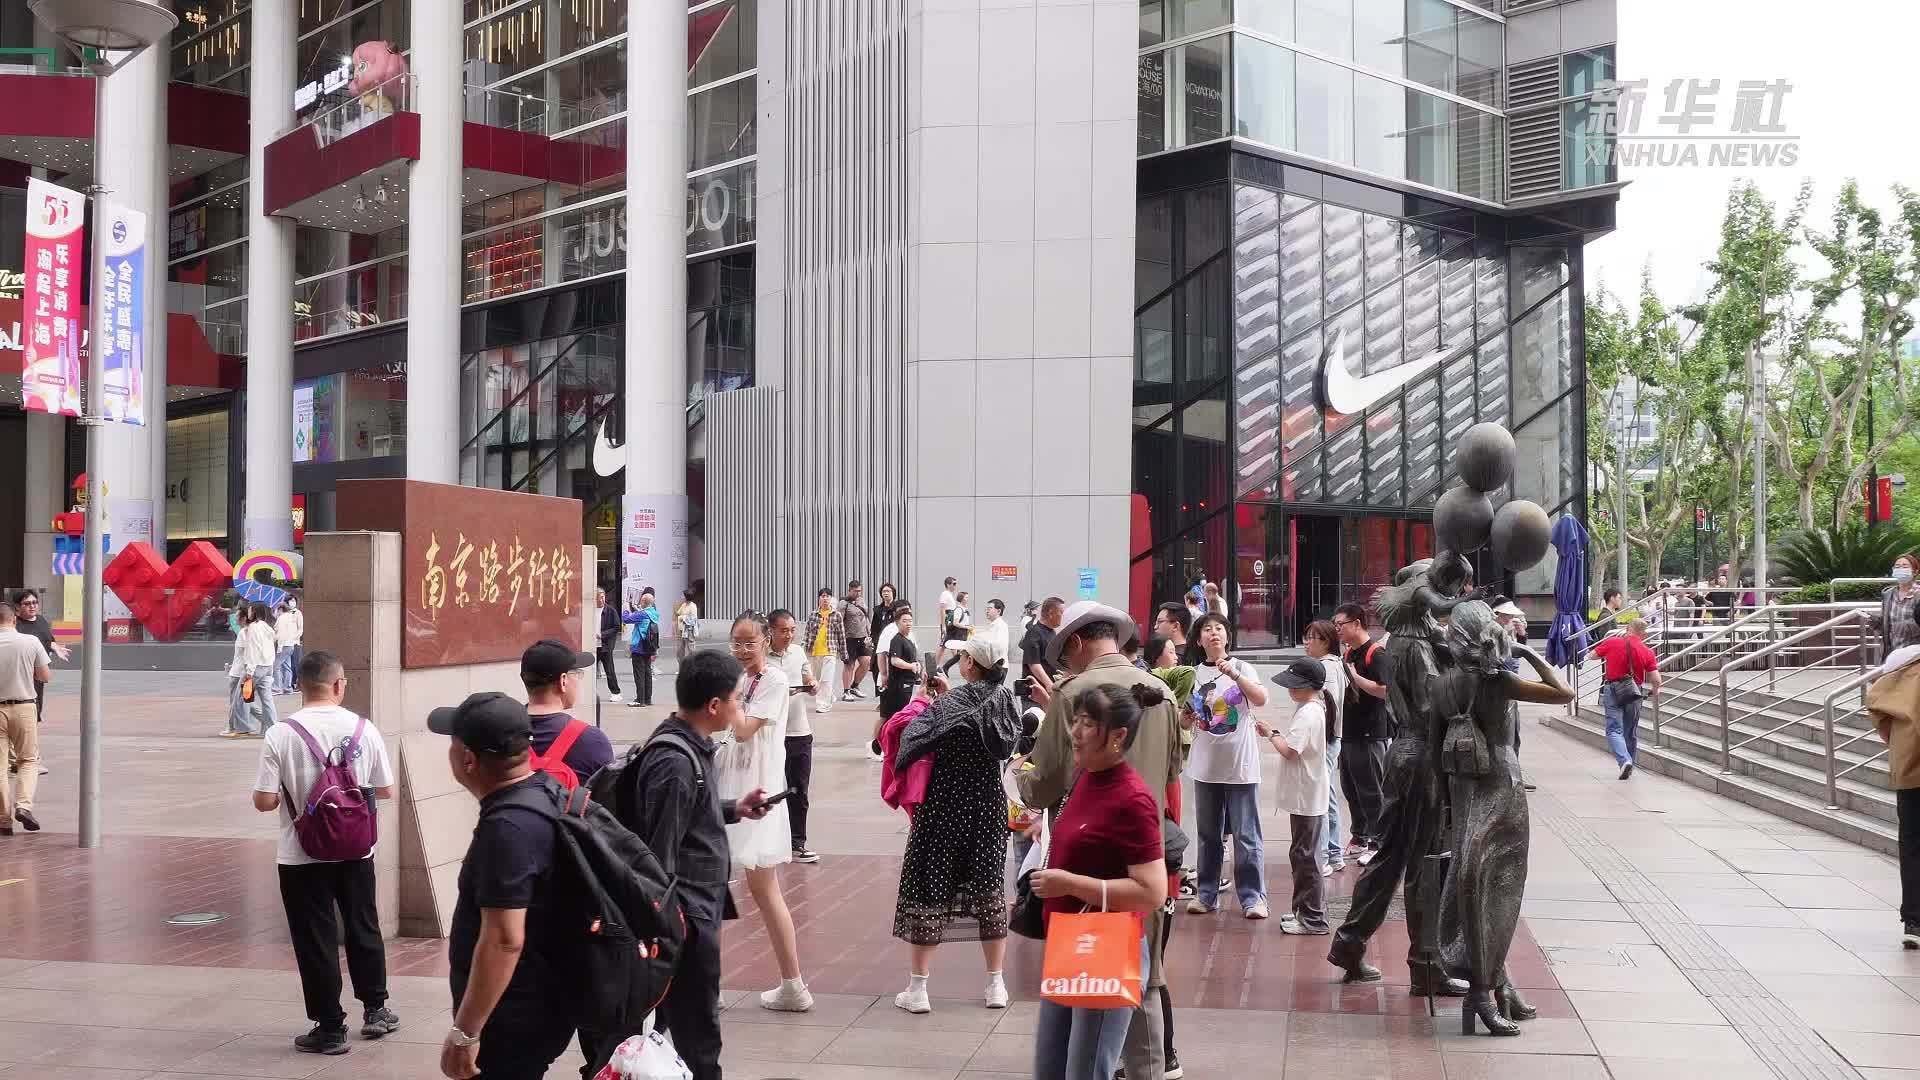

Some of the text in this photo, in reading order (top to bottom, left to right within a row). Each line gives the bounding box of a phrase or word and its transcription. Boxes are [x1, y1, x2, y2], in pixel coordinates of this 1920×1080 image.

[1139, 67, 1162, 84] OUSE
[421, 528, 574, 622] 南京路步行街
